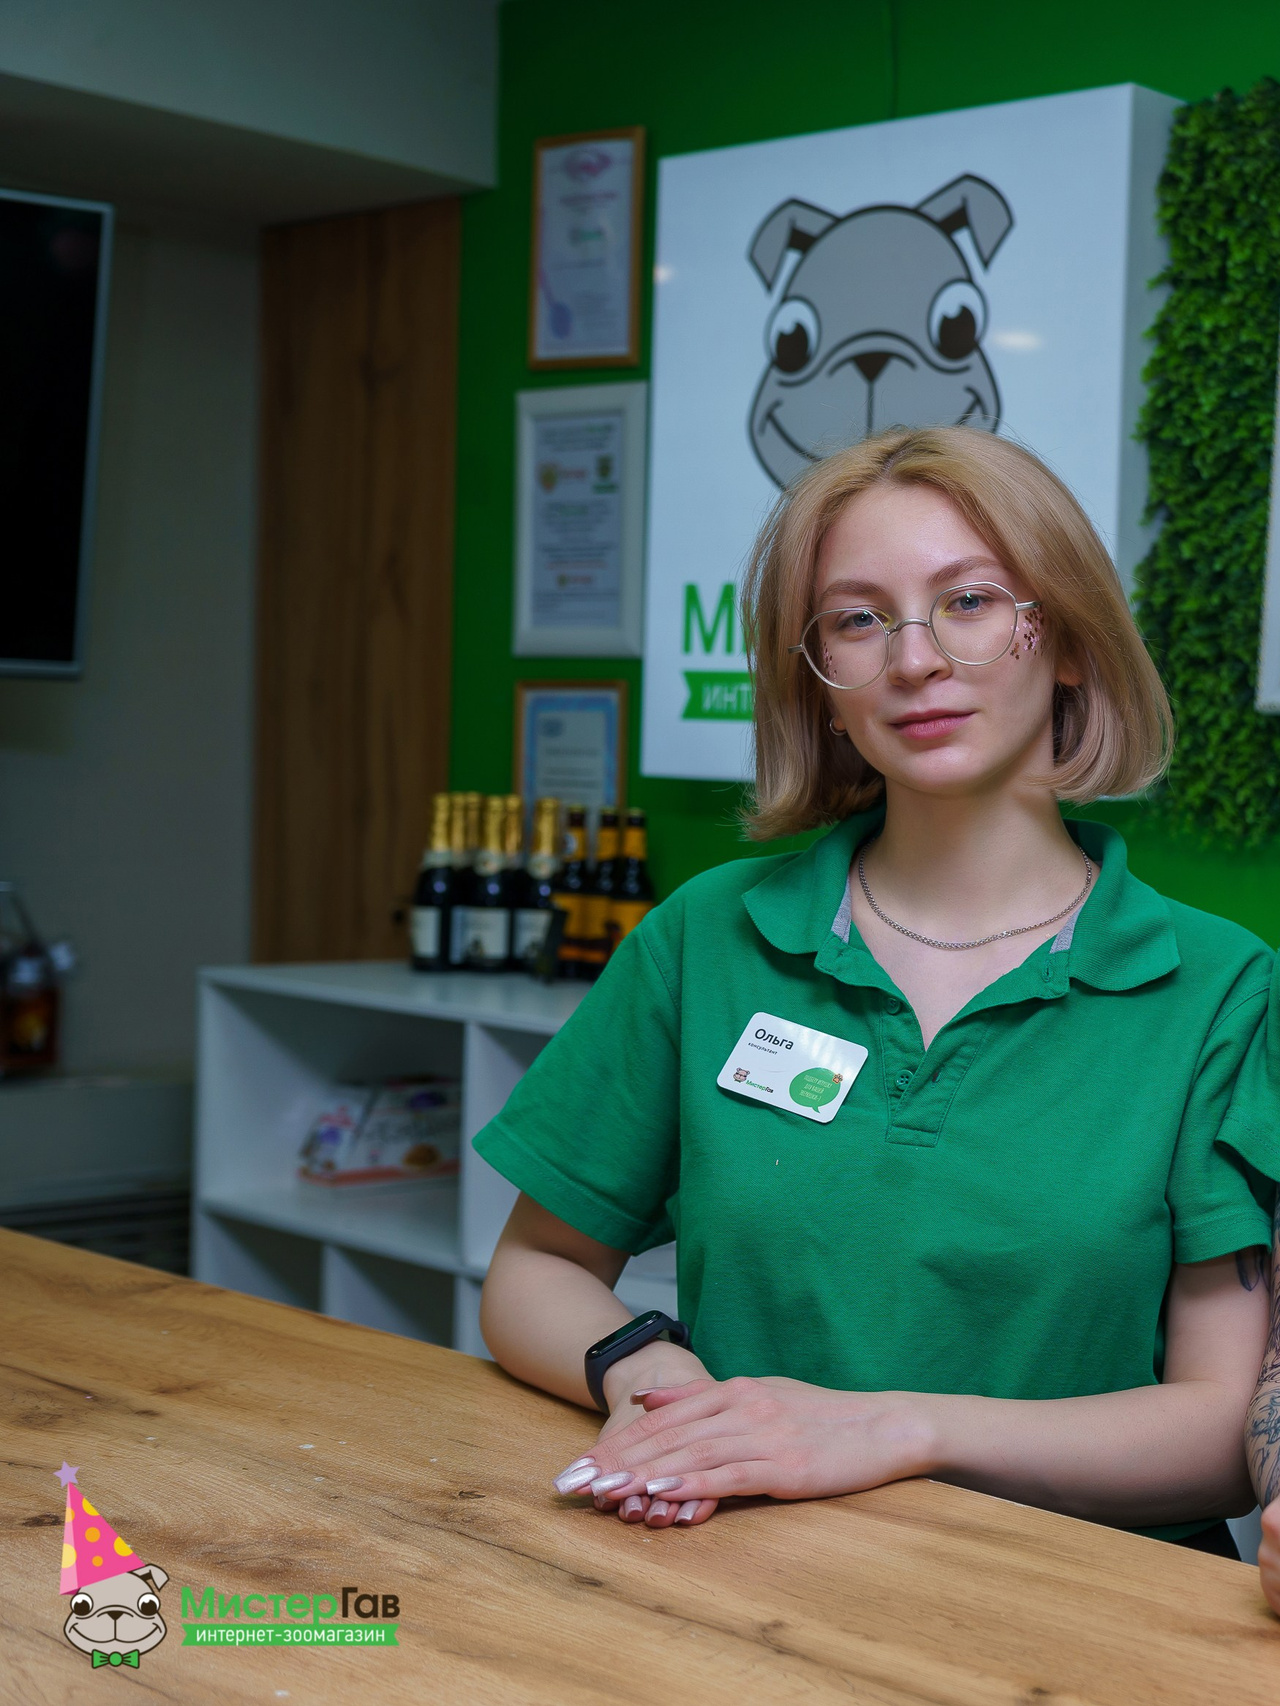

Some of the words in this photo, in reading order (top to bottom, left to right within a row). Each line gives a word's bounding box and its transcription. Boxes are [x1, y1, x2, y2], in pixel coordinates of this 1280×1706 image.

[754, 1028, 794, 1050] Ольга
[747, 1042, 778, 1056] консультант
[745, 1079, 774, 1094] МистерГав
